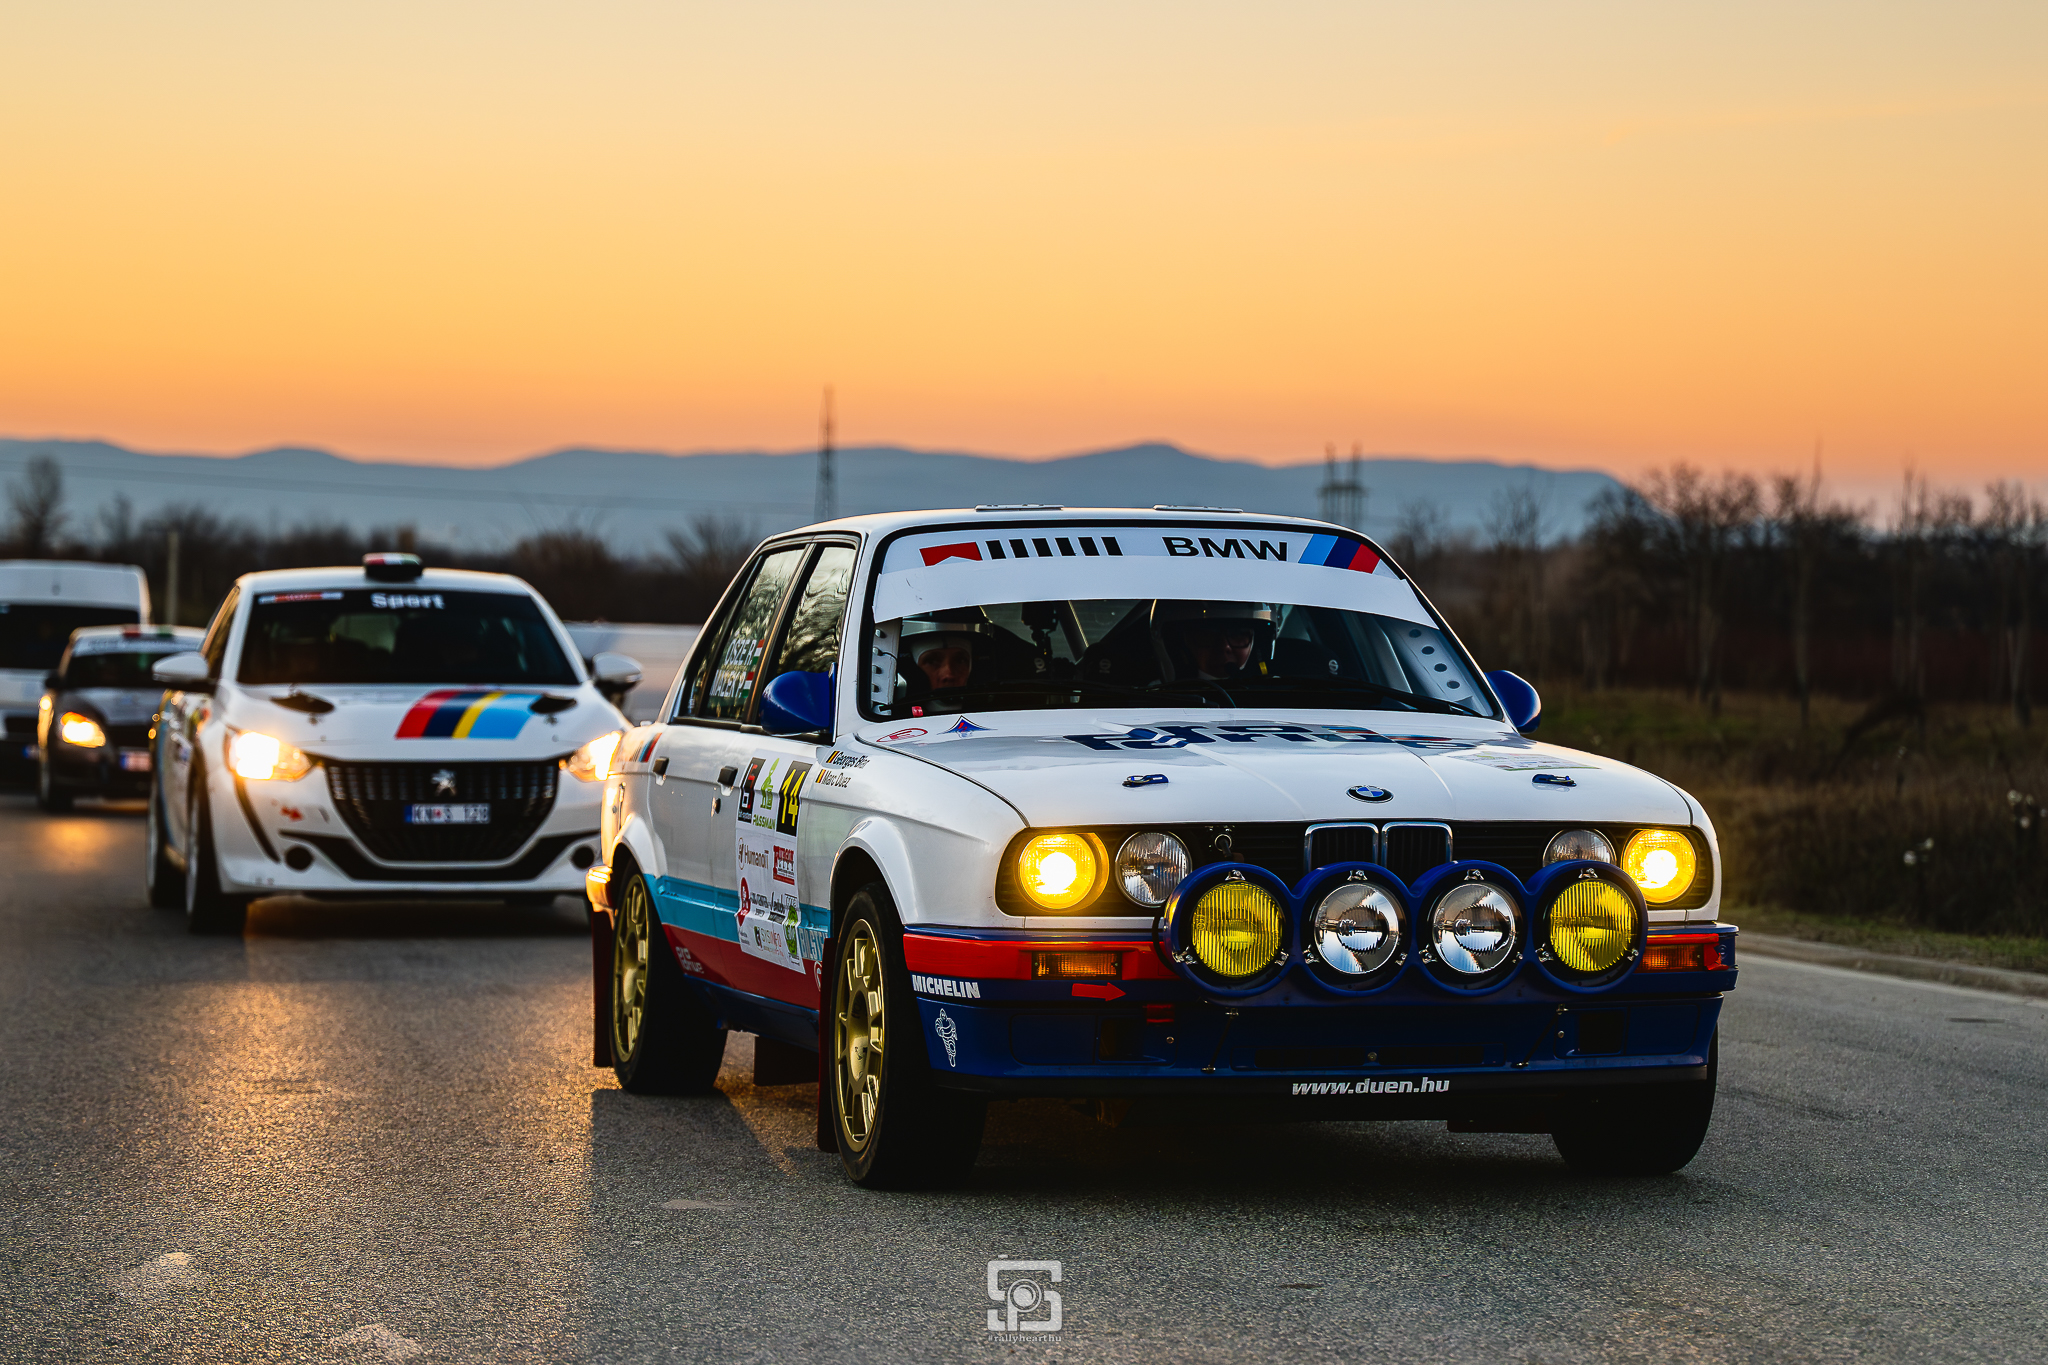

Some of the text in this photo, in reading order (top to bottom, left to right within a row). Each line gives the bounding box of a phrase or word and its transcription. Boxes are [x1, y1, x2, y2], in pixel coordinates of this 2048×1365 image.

[1161, 536, 1289, 562] BMW
[371, 592, 446, 610] Sport
[833, 751, 858, 770] Georges
[781, 768, 807, 828] 14
[911, 974, 981, 999] MICHELIN
[1292, 1076, 1450, 1096] www.duen.hu
